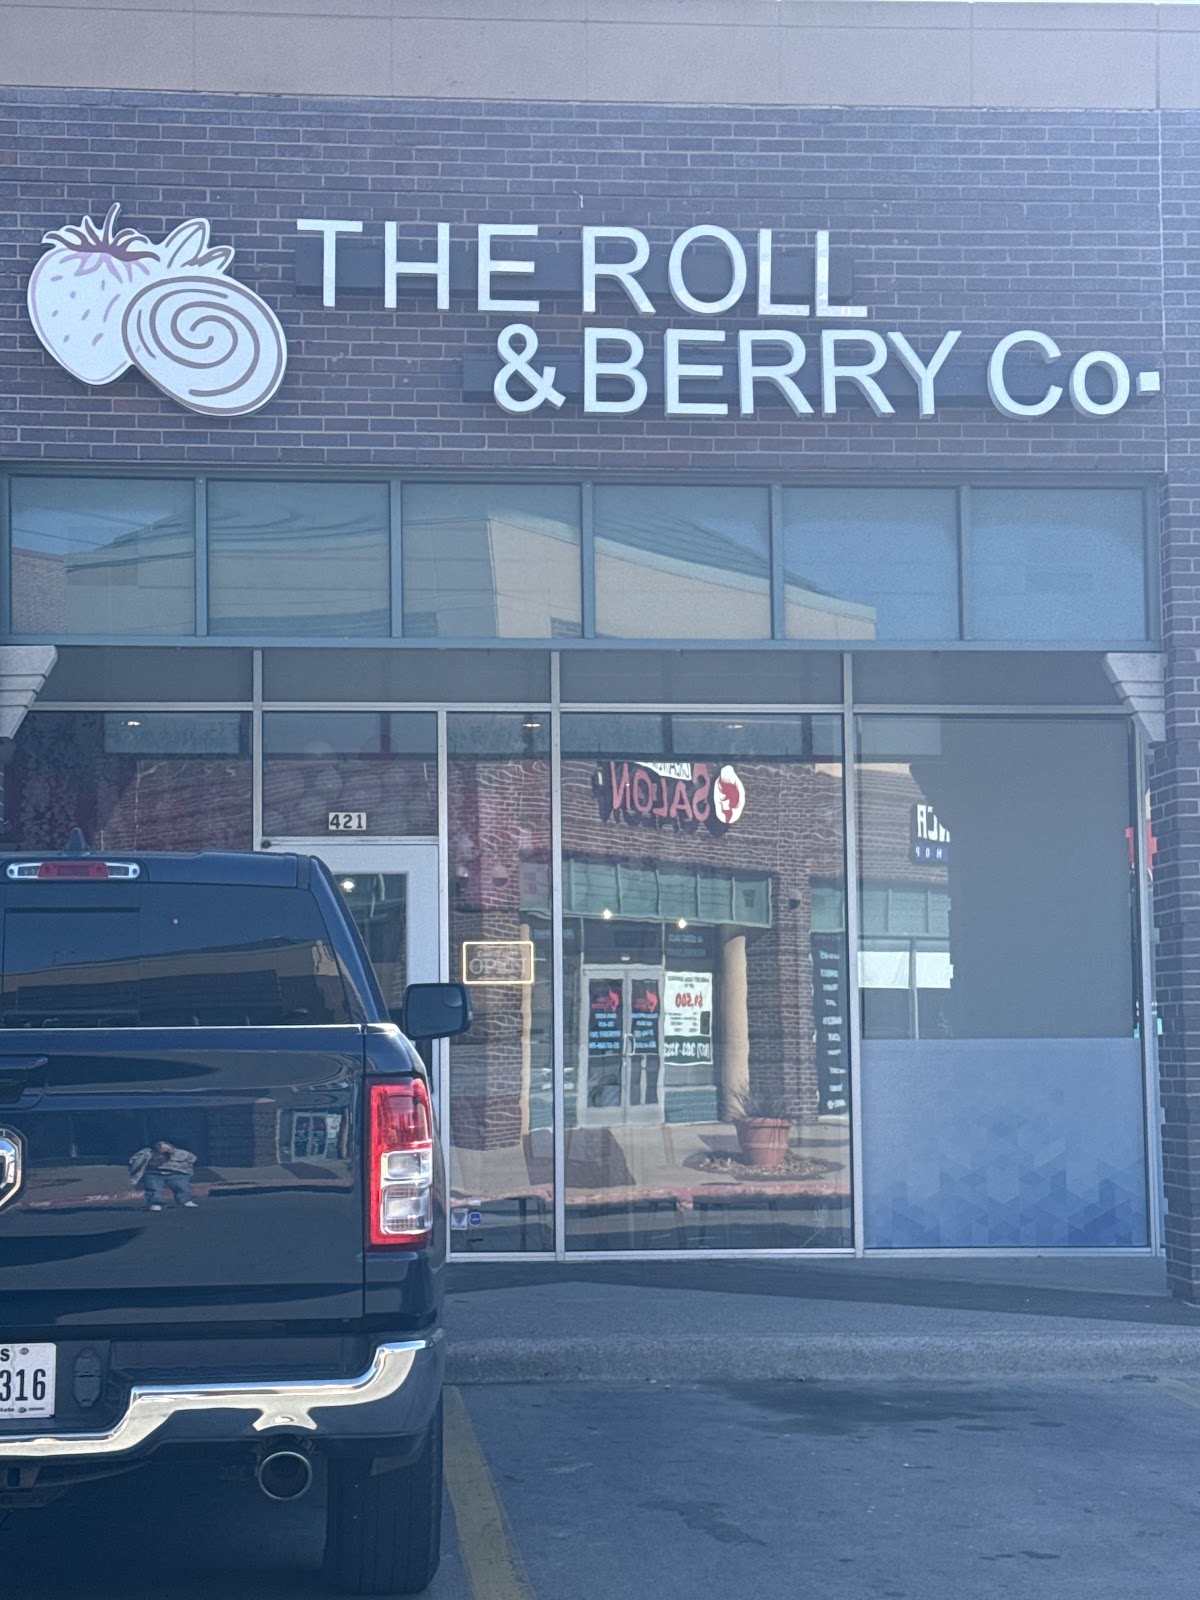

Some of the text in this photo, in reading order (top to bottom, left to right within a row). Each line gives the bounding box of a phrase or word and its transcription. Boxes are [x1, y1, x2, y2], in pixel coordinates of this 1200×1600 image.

[297, 218, 868, 318] THE ROLL
[494, 323, 567, 414] &
[584, 327, 963, 418] BERRY
[329, 813, 364, 829] 421
[468, 958, 527, 975] OPEN
[0, 1368, 46, 1402] 316
